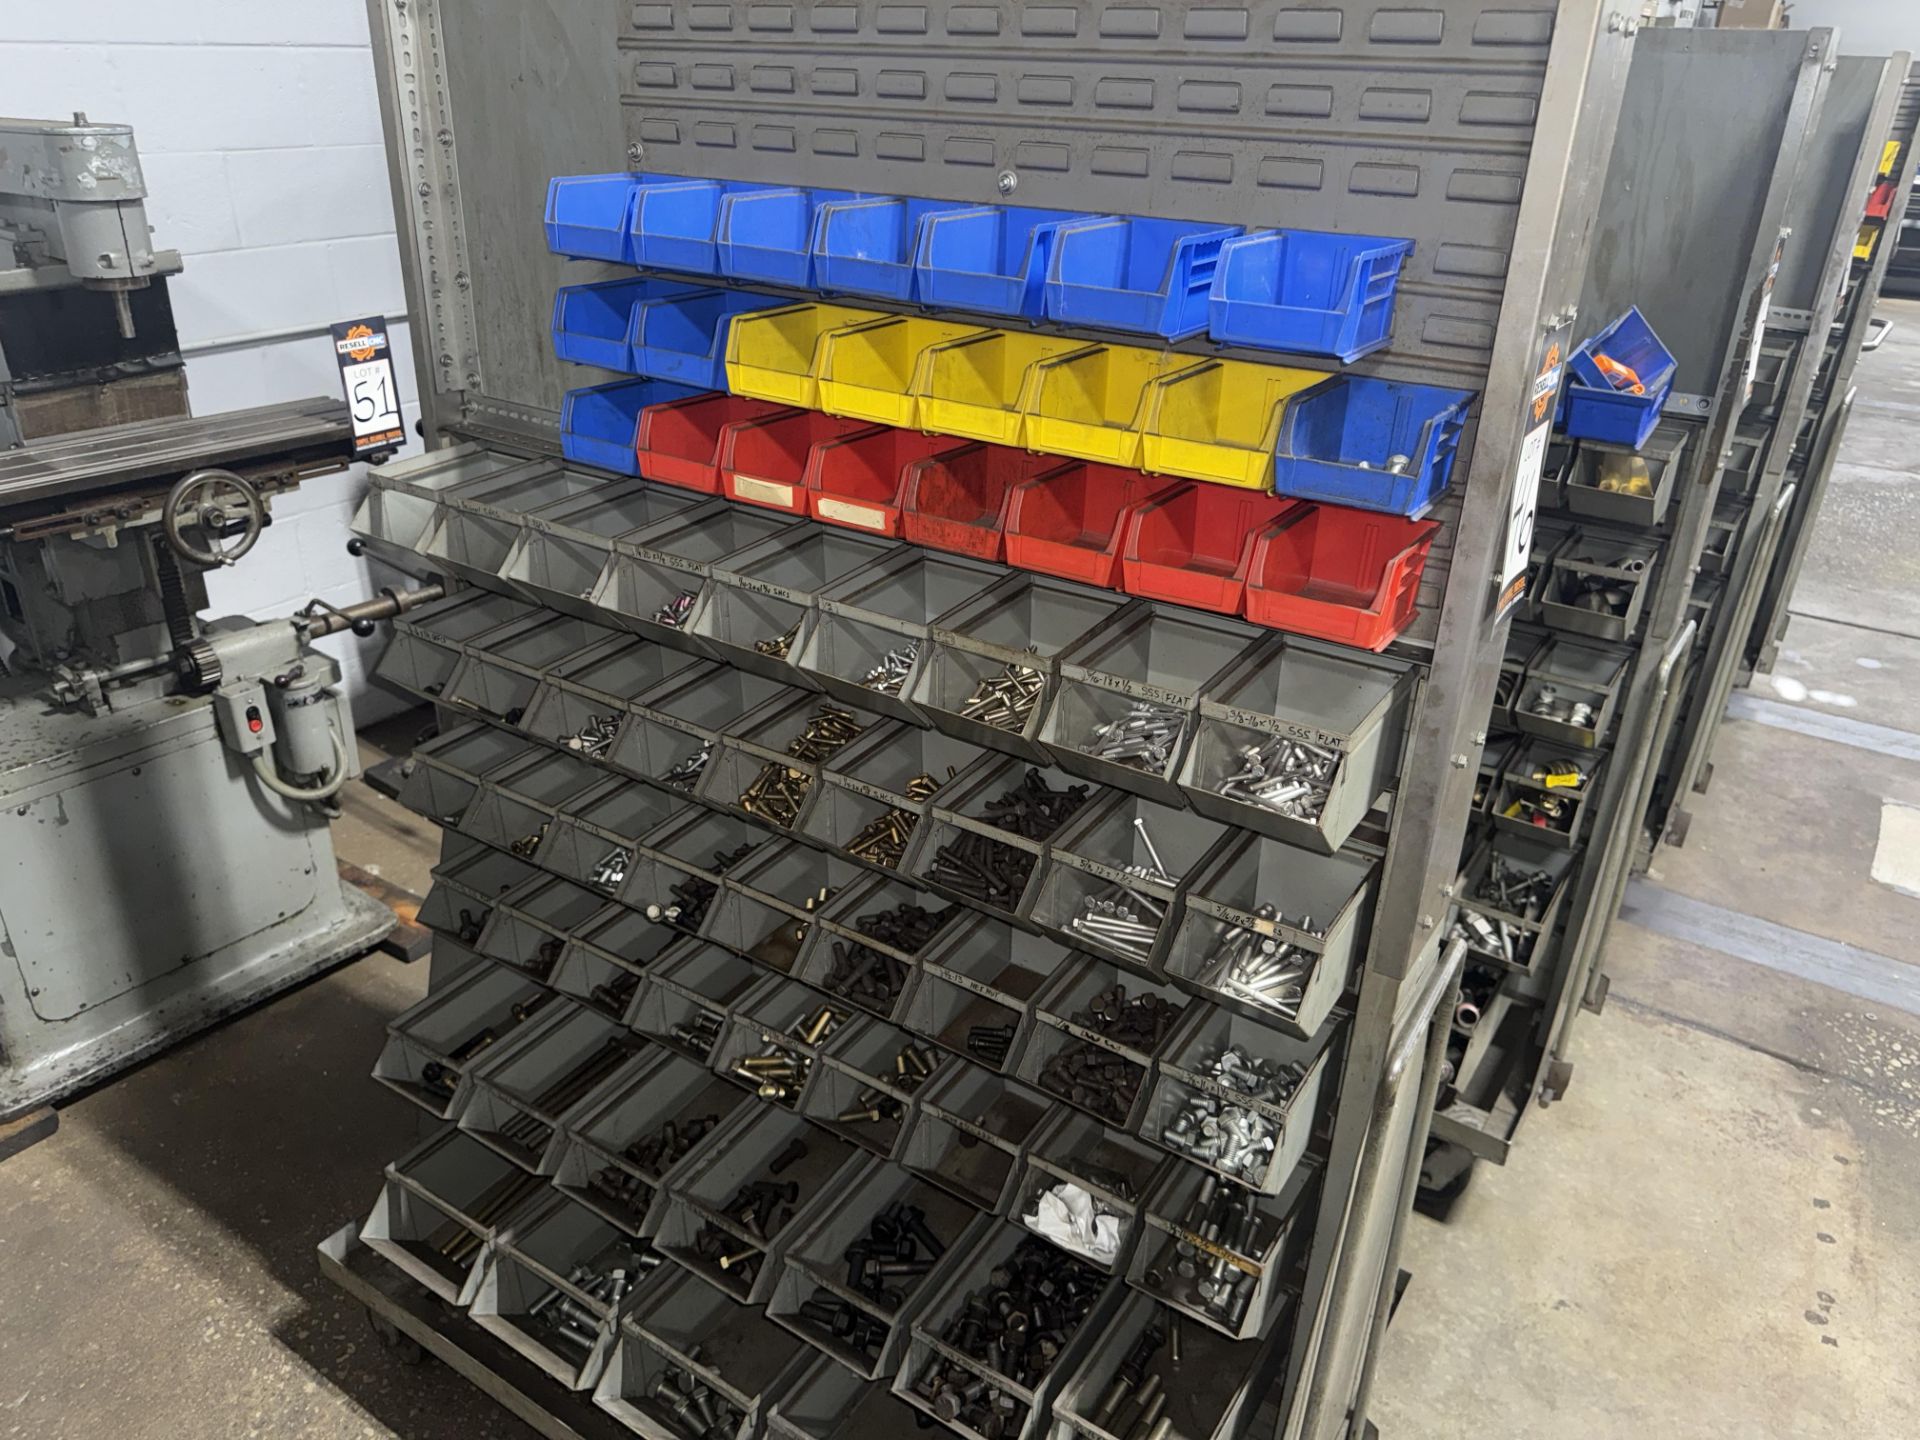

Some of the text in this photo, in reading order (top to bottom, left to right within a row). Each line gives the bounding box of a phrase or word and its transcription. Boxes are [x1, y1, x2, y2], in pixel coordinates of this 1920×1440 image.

[353, 367, 372, 379] LOT
[353, 376, 400, 423] 51
[1166, 692, 1191, 707] FLAT
[1288, 726, 1311, 740] SSS
[1318, 733, 1342, 747] FLAT
